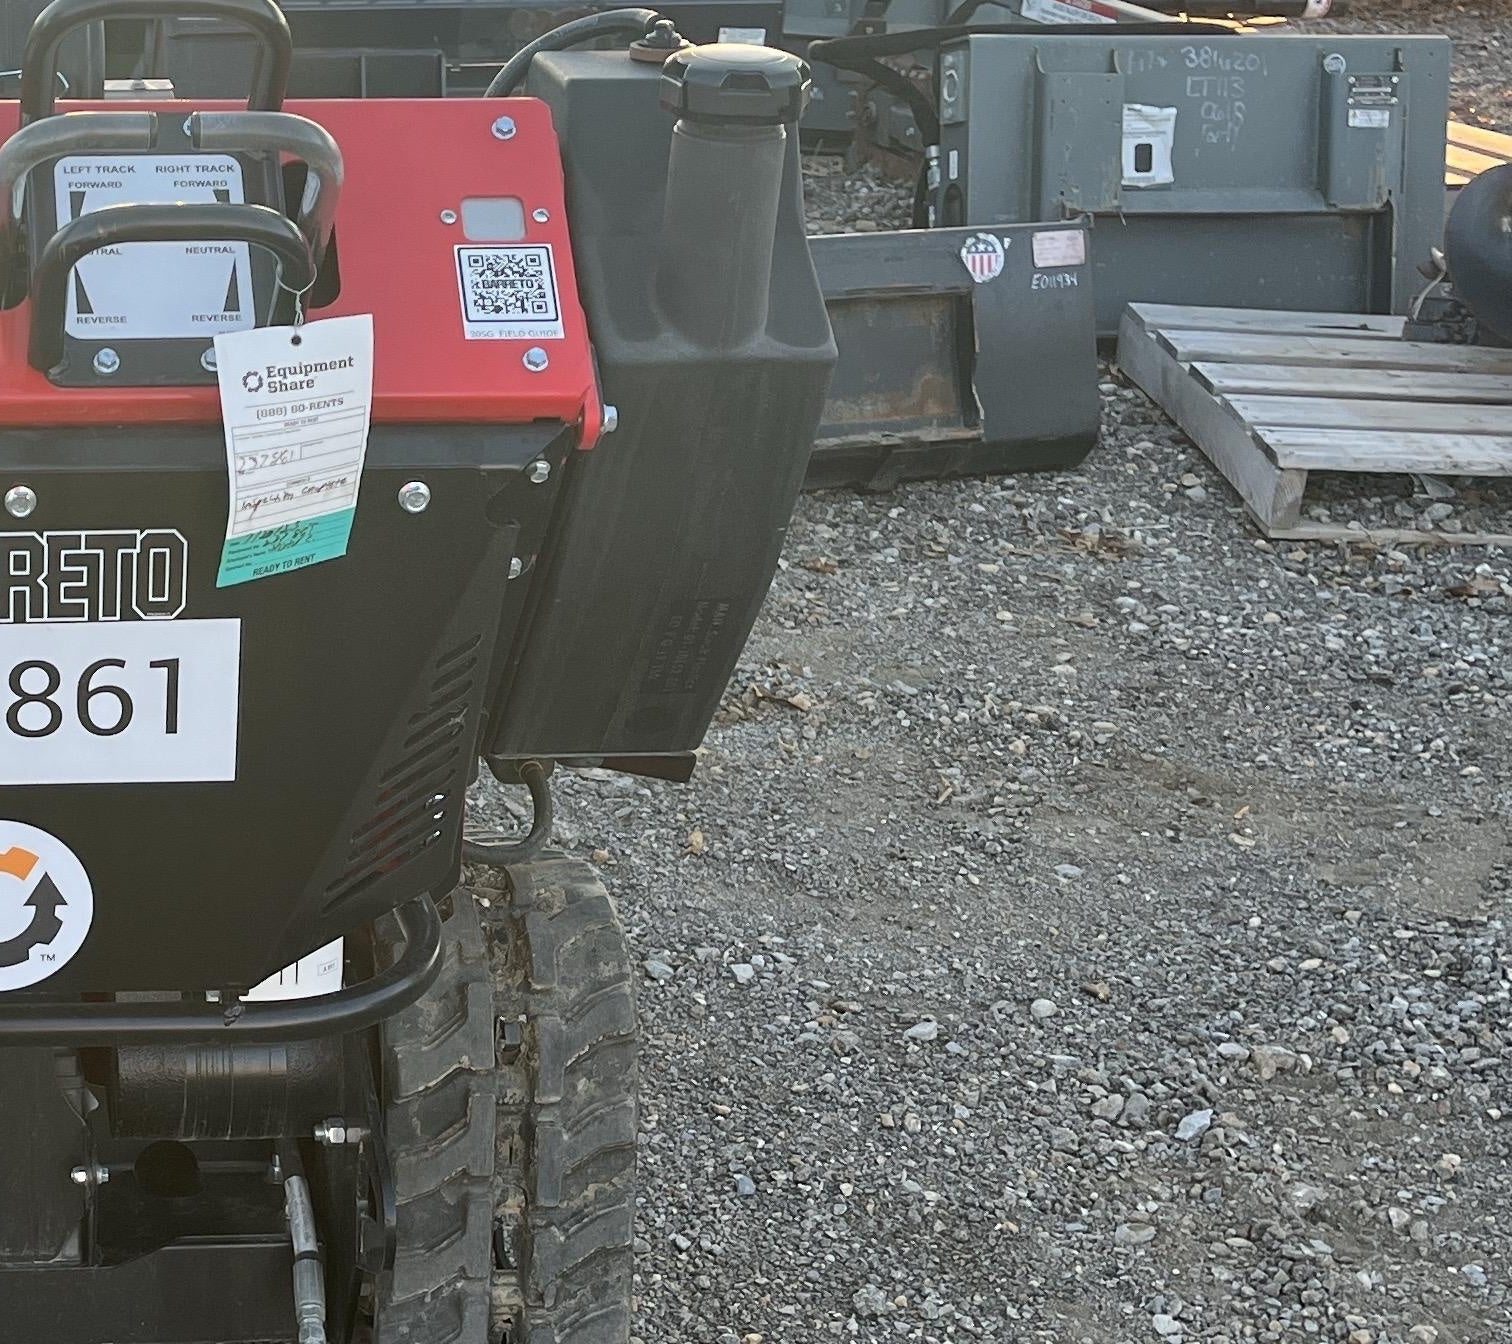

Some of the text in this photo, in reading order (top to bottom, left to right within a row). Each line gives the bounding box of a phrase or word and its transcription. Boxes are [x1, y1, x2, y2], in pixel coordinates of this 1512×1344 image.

[63, 165, 137, 174] LEFT TRACK
[155, 164, 235, 173] RIGHT TRACK
[68, 181, 123, 189] FORWARD
[173, 180, 228, 188] FORWARD
[185, 246, 236, 254] NEUTRAL
[76, 315, 128, 324] REVERSE
[191, 314, 243, 322] REVERSE
[266, 356, 355, 381] Equipment
[267, 378, 315, 394] Share
[252, 553, 317, 577] READY TO RENT
[40, 953, 56, 962] TM
